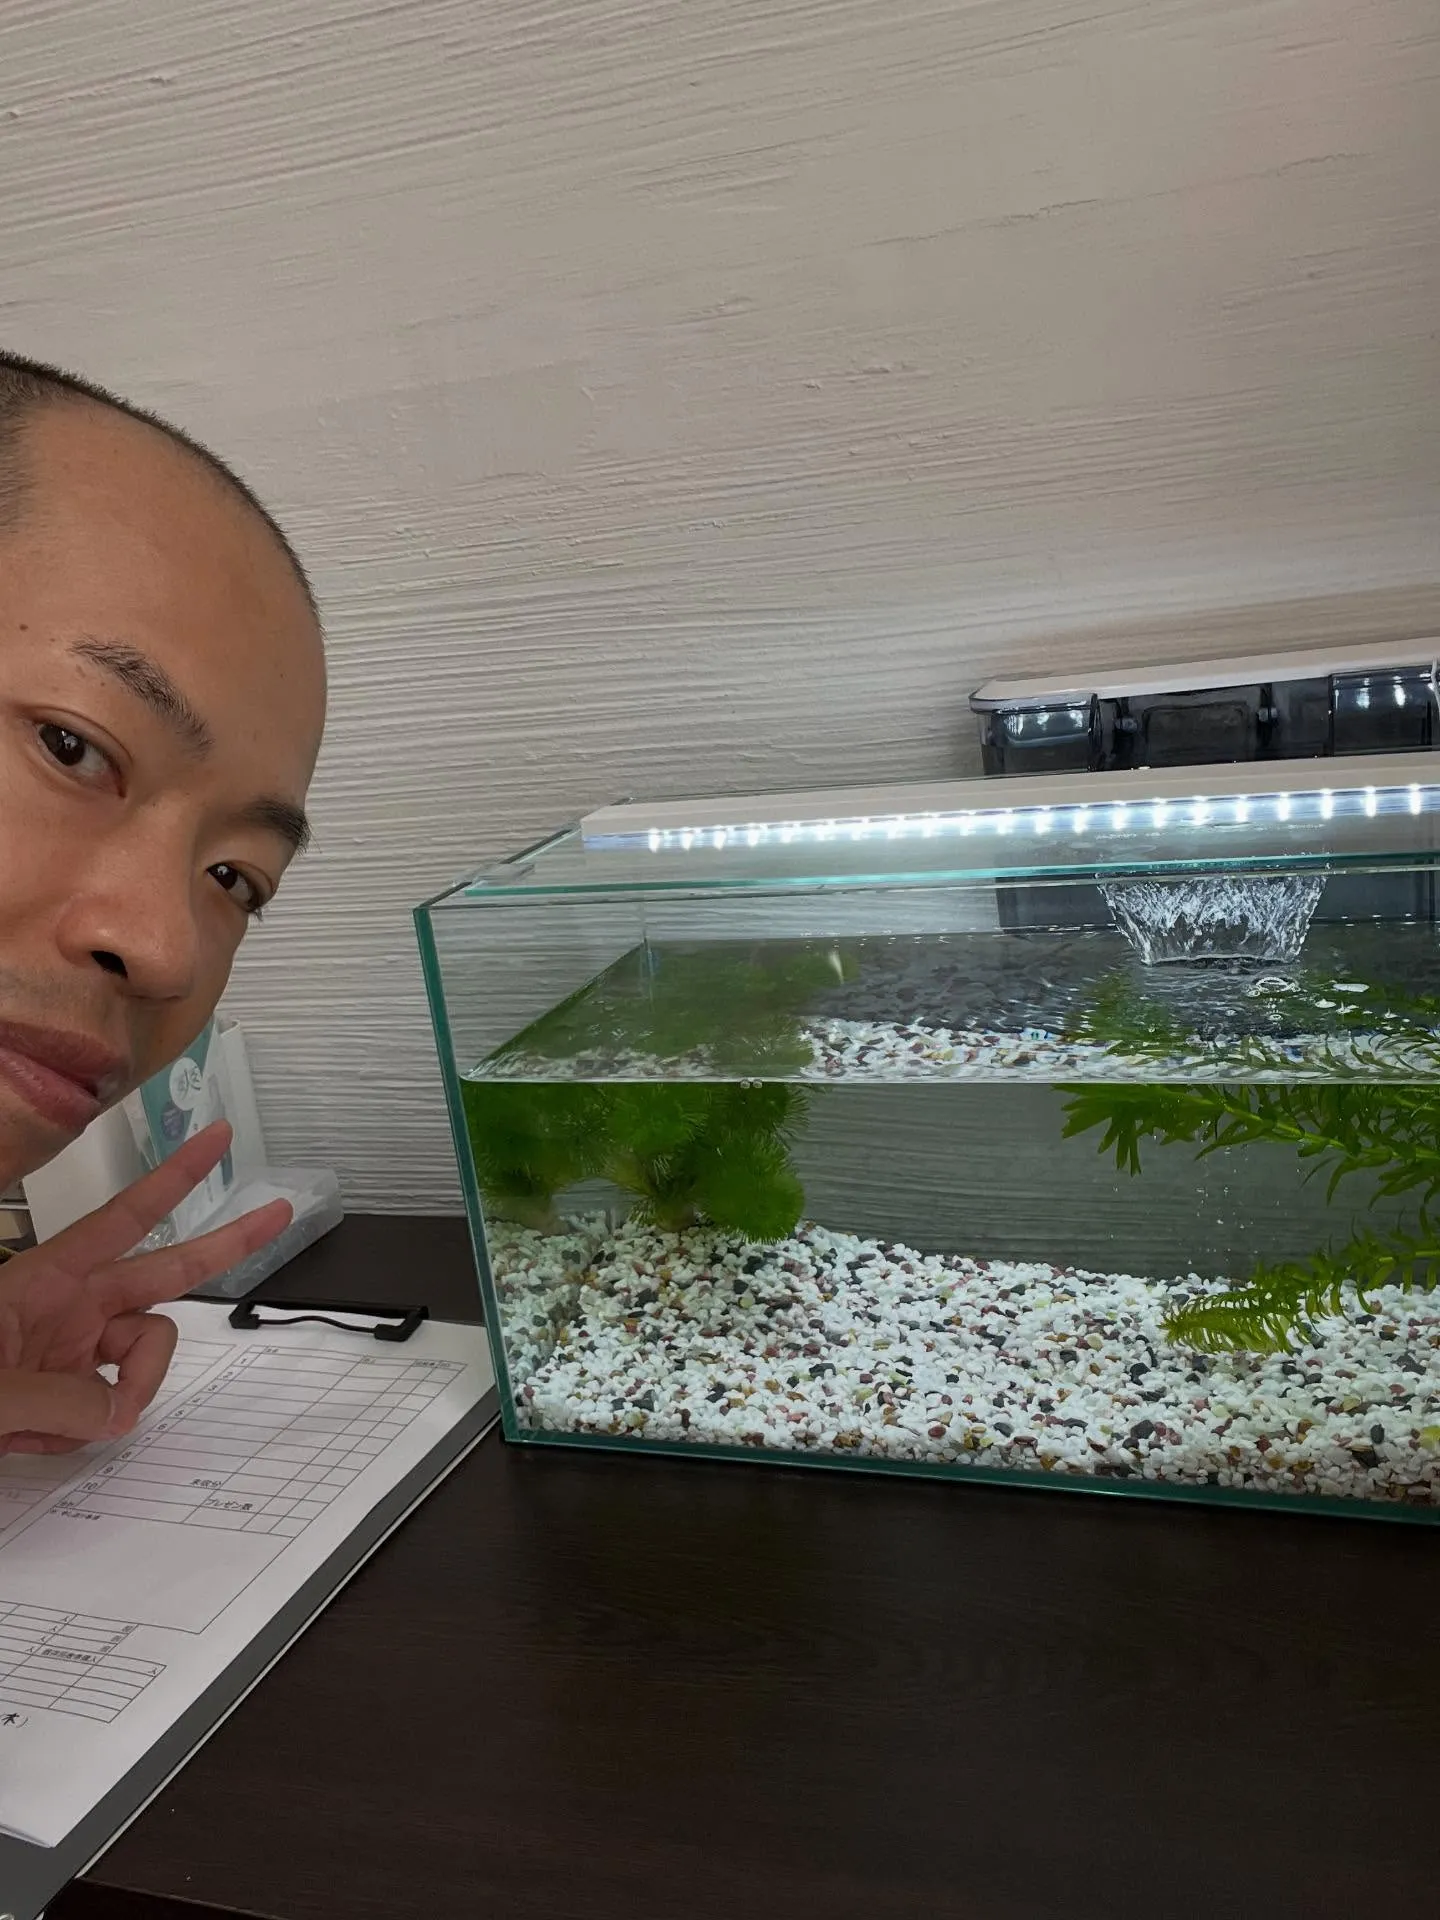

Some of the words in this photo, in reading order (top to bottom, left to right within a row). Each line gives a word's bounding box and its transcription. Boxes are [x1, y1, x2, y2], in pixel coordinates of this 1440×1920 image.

[240, 1357, 248, 1365] 1
[222, 1371, 234, 1379] 2
[207, 1384, 218, 1392] 3
[174, 1409, 186, 1417] 5
[157, 1423, 168, 1431] 6
[82, 1481, 99, 1491] 10
